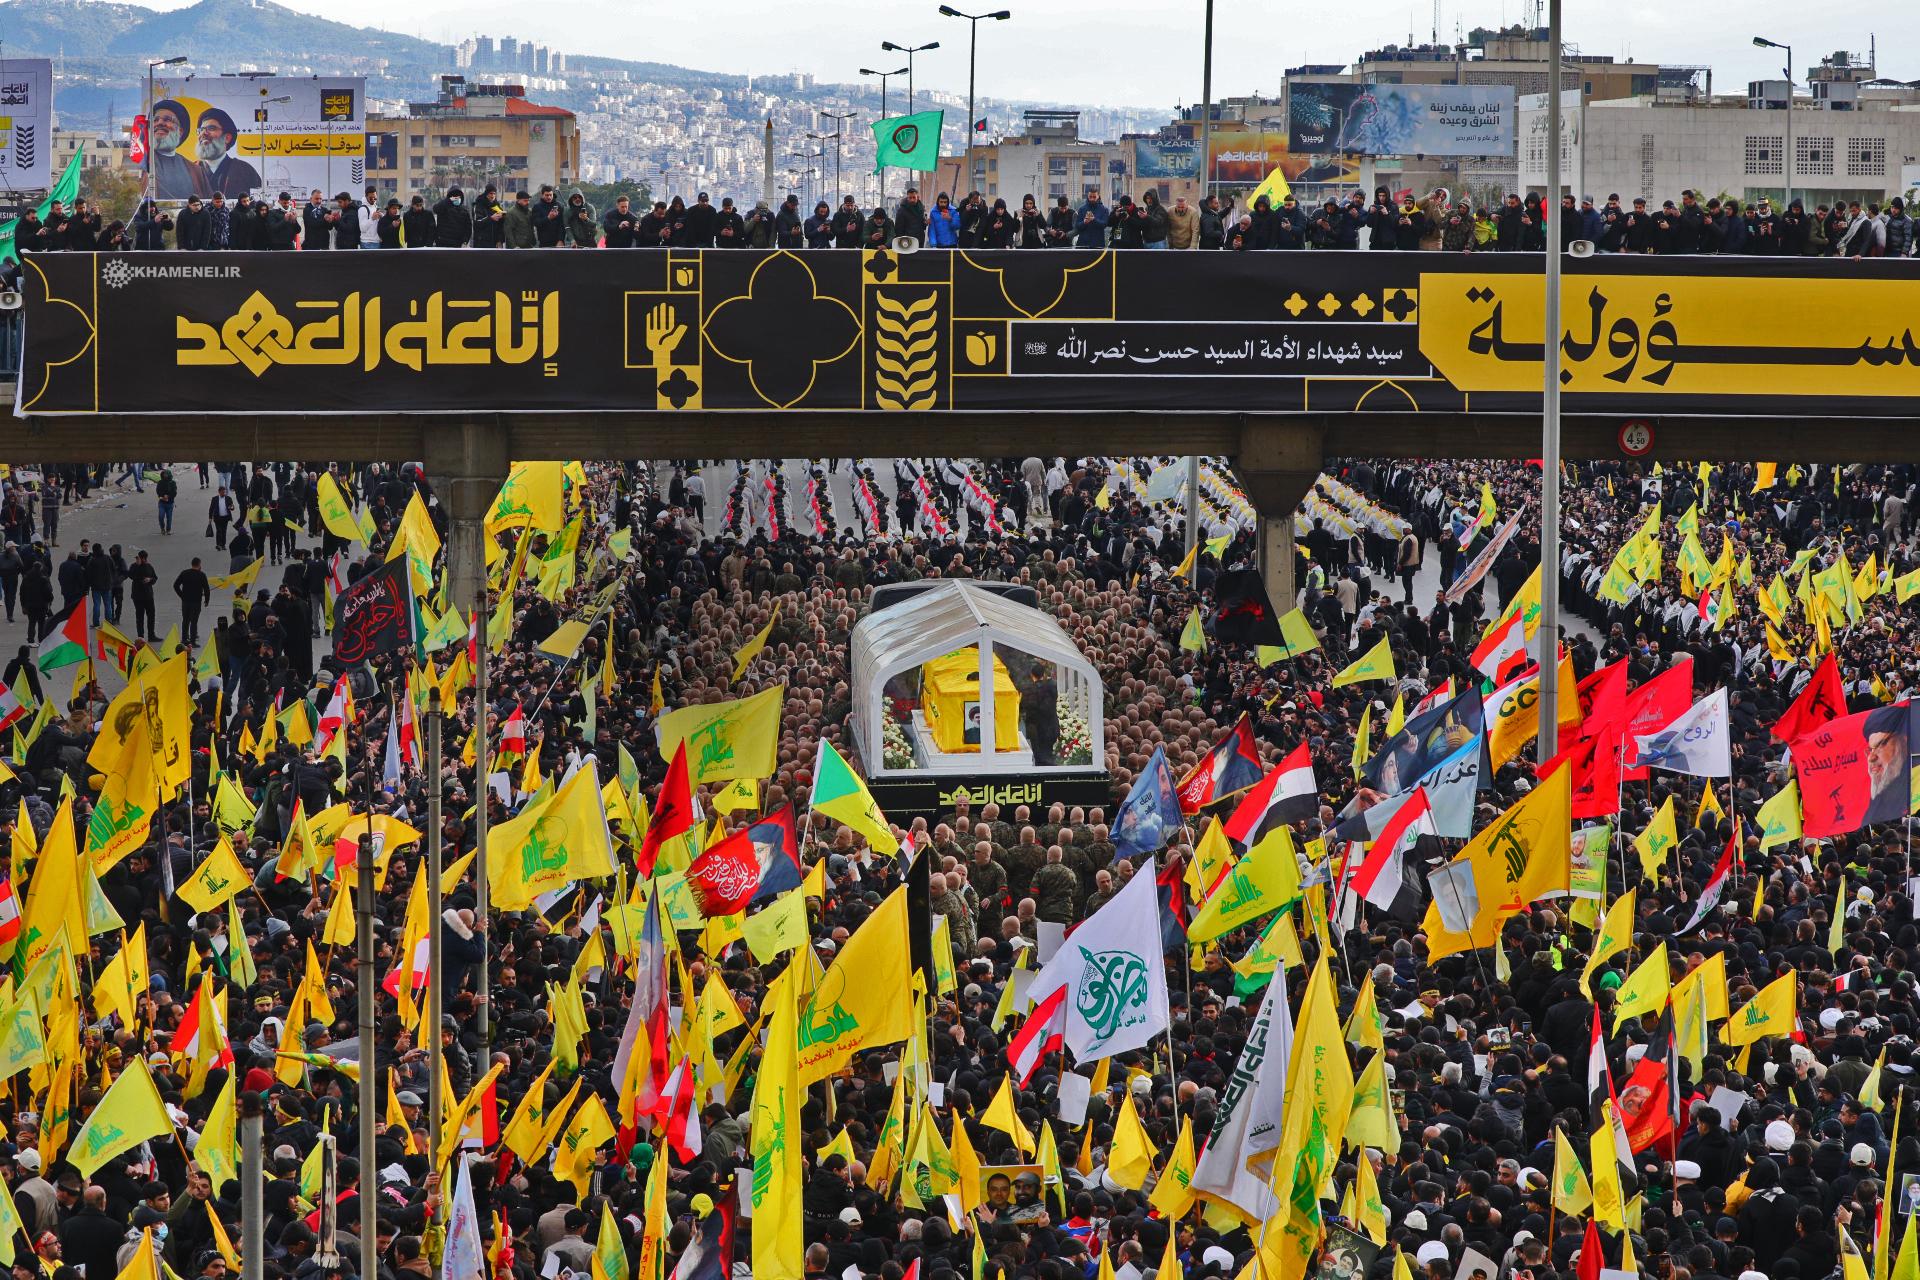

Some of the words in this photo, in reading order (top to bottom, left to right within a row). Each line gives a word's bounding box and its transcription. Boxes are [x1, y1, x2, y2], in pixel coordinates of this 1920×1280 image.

[1430, 103, 1447, 114] زينة
[1479, 104, 1500, 114] لبنان
[1470, 116, 1500, 127] الشرق
[284, 138, 323, 154] نكمل
[176, 290, 381, 377] العهد
[1056, 327, 1088, 360] الله
[1089, 340, 1127, 364] نصر
[1128, 344, 1199, 364] حسن
[1204, 341, 1254, 366] السيد
[1259, 334, 1300, 361] الأمة
[1306, 341, 1361, 362] شهداء
[1366, 345, 1403, 366] سيد
[1683, 720, 1716, 743] الروح
